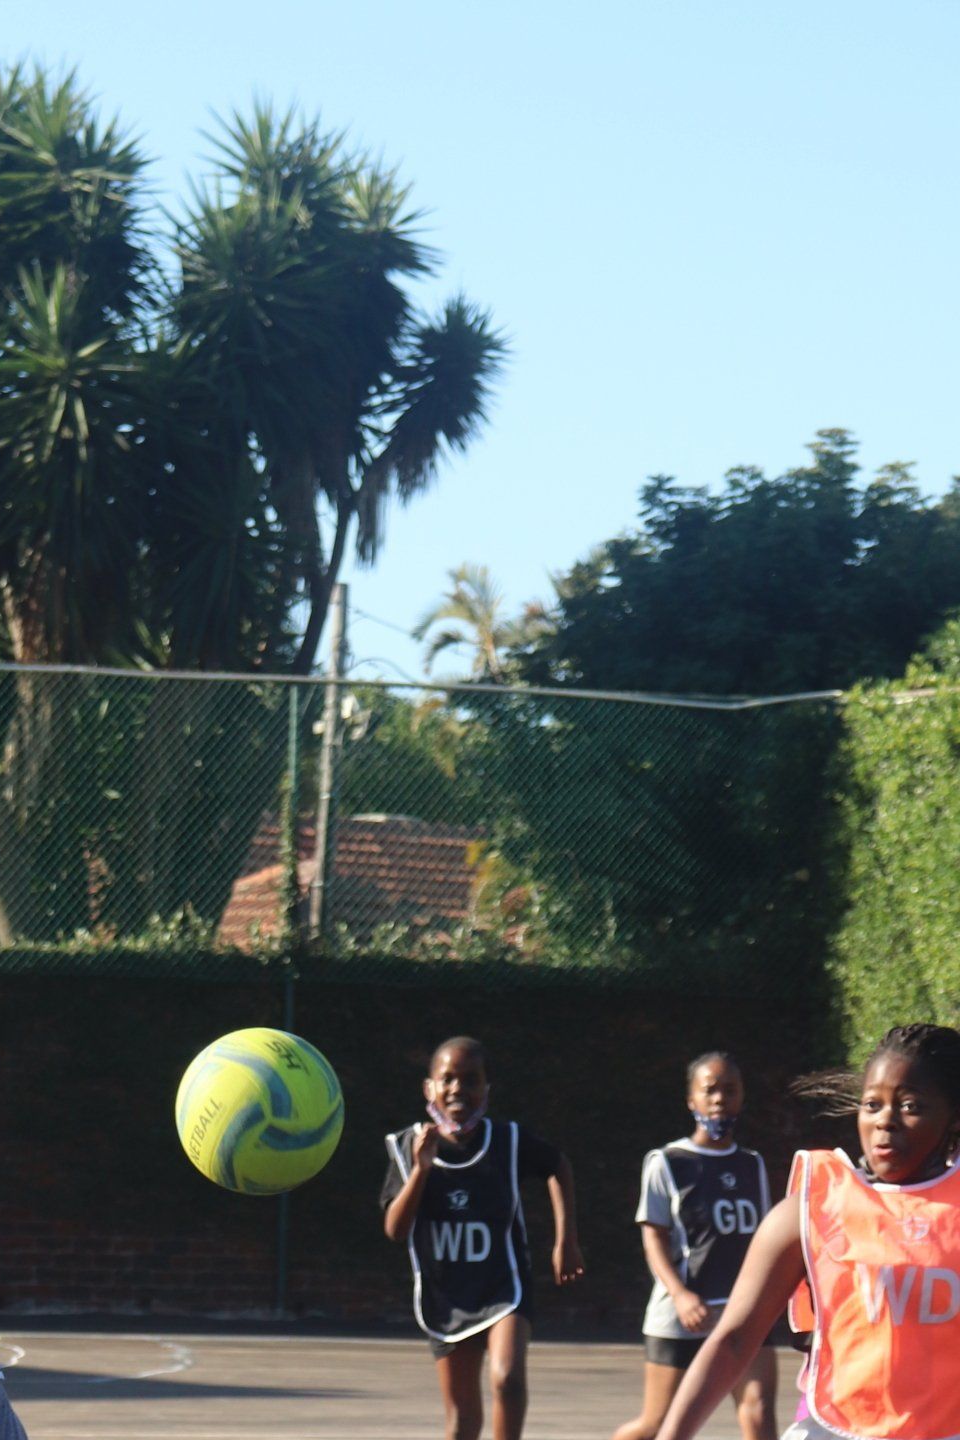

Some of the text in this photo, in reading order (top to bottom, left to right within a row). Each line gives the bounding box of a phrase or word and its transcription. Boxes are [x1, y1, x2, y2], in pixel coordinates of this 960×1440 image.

[713, 1199, 758, 1234] GD
[431, 1221, 491, 1262] WD
[855, 1263, 960, 1325] WD
